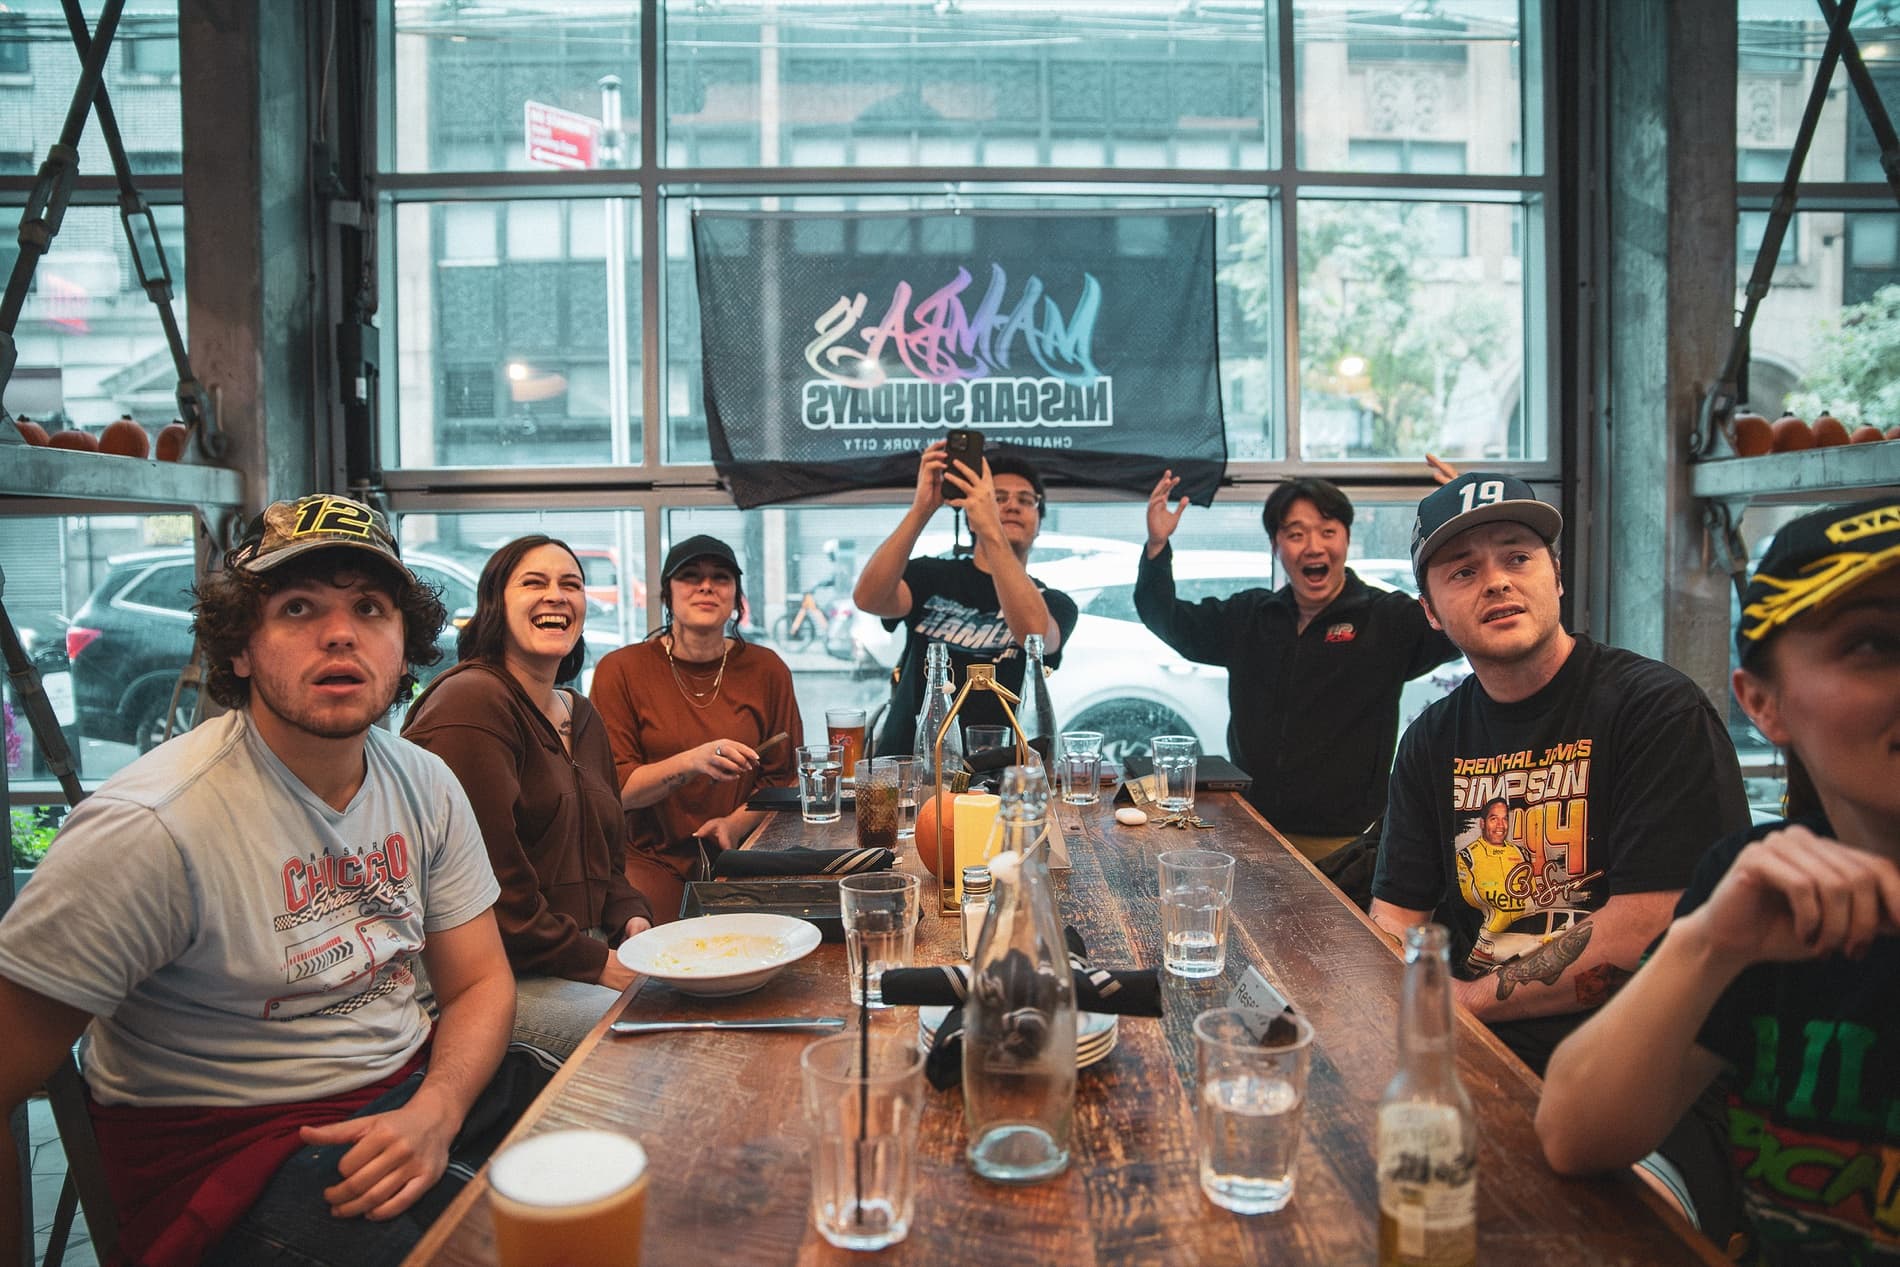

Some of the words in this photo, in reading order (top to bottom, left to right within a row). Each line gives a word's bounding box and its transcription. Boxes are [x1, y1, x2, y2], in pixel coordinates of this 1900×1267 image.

[1459, 480, 1505, 513] 19
[292, 497, 373, 539] 12
[914, 611, 1017, 650] HAMLI
